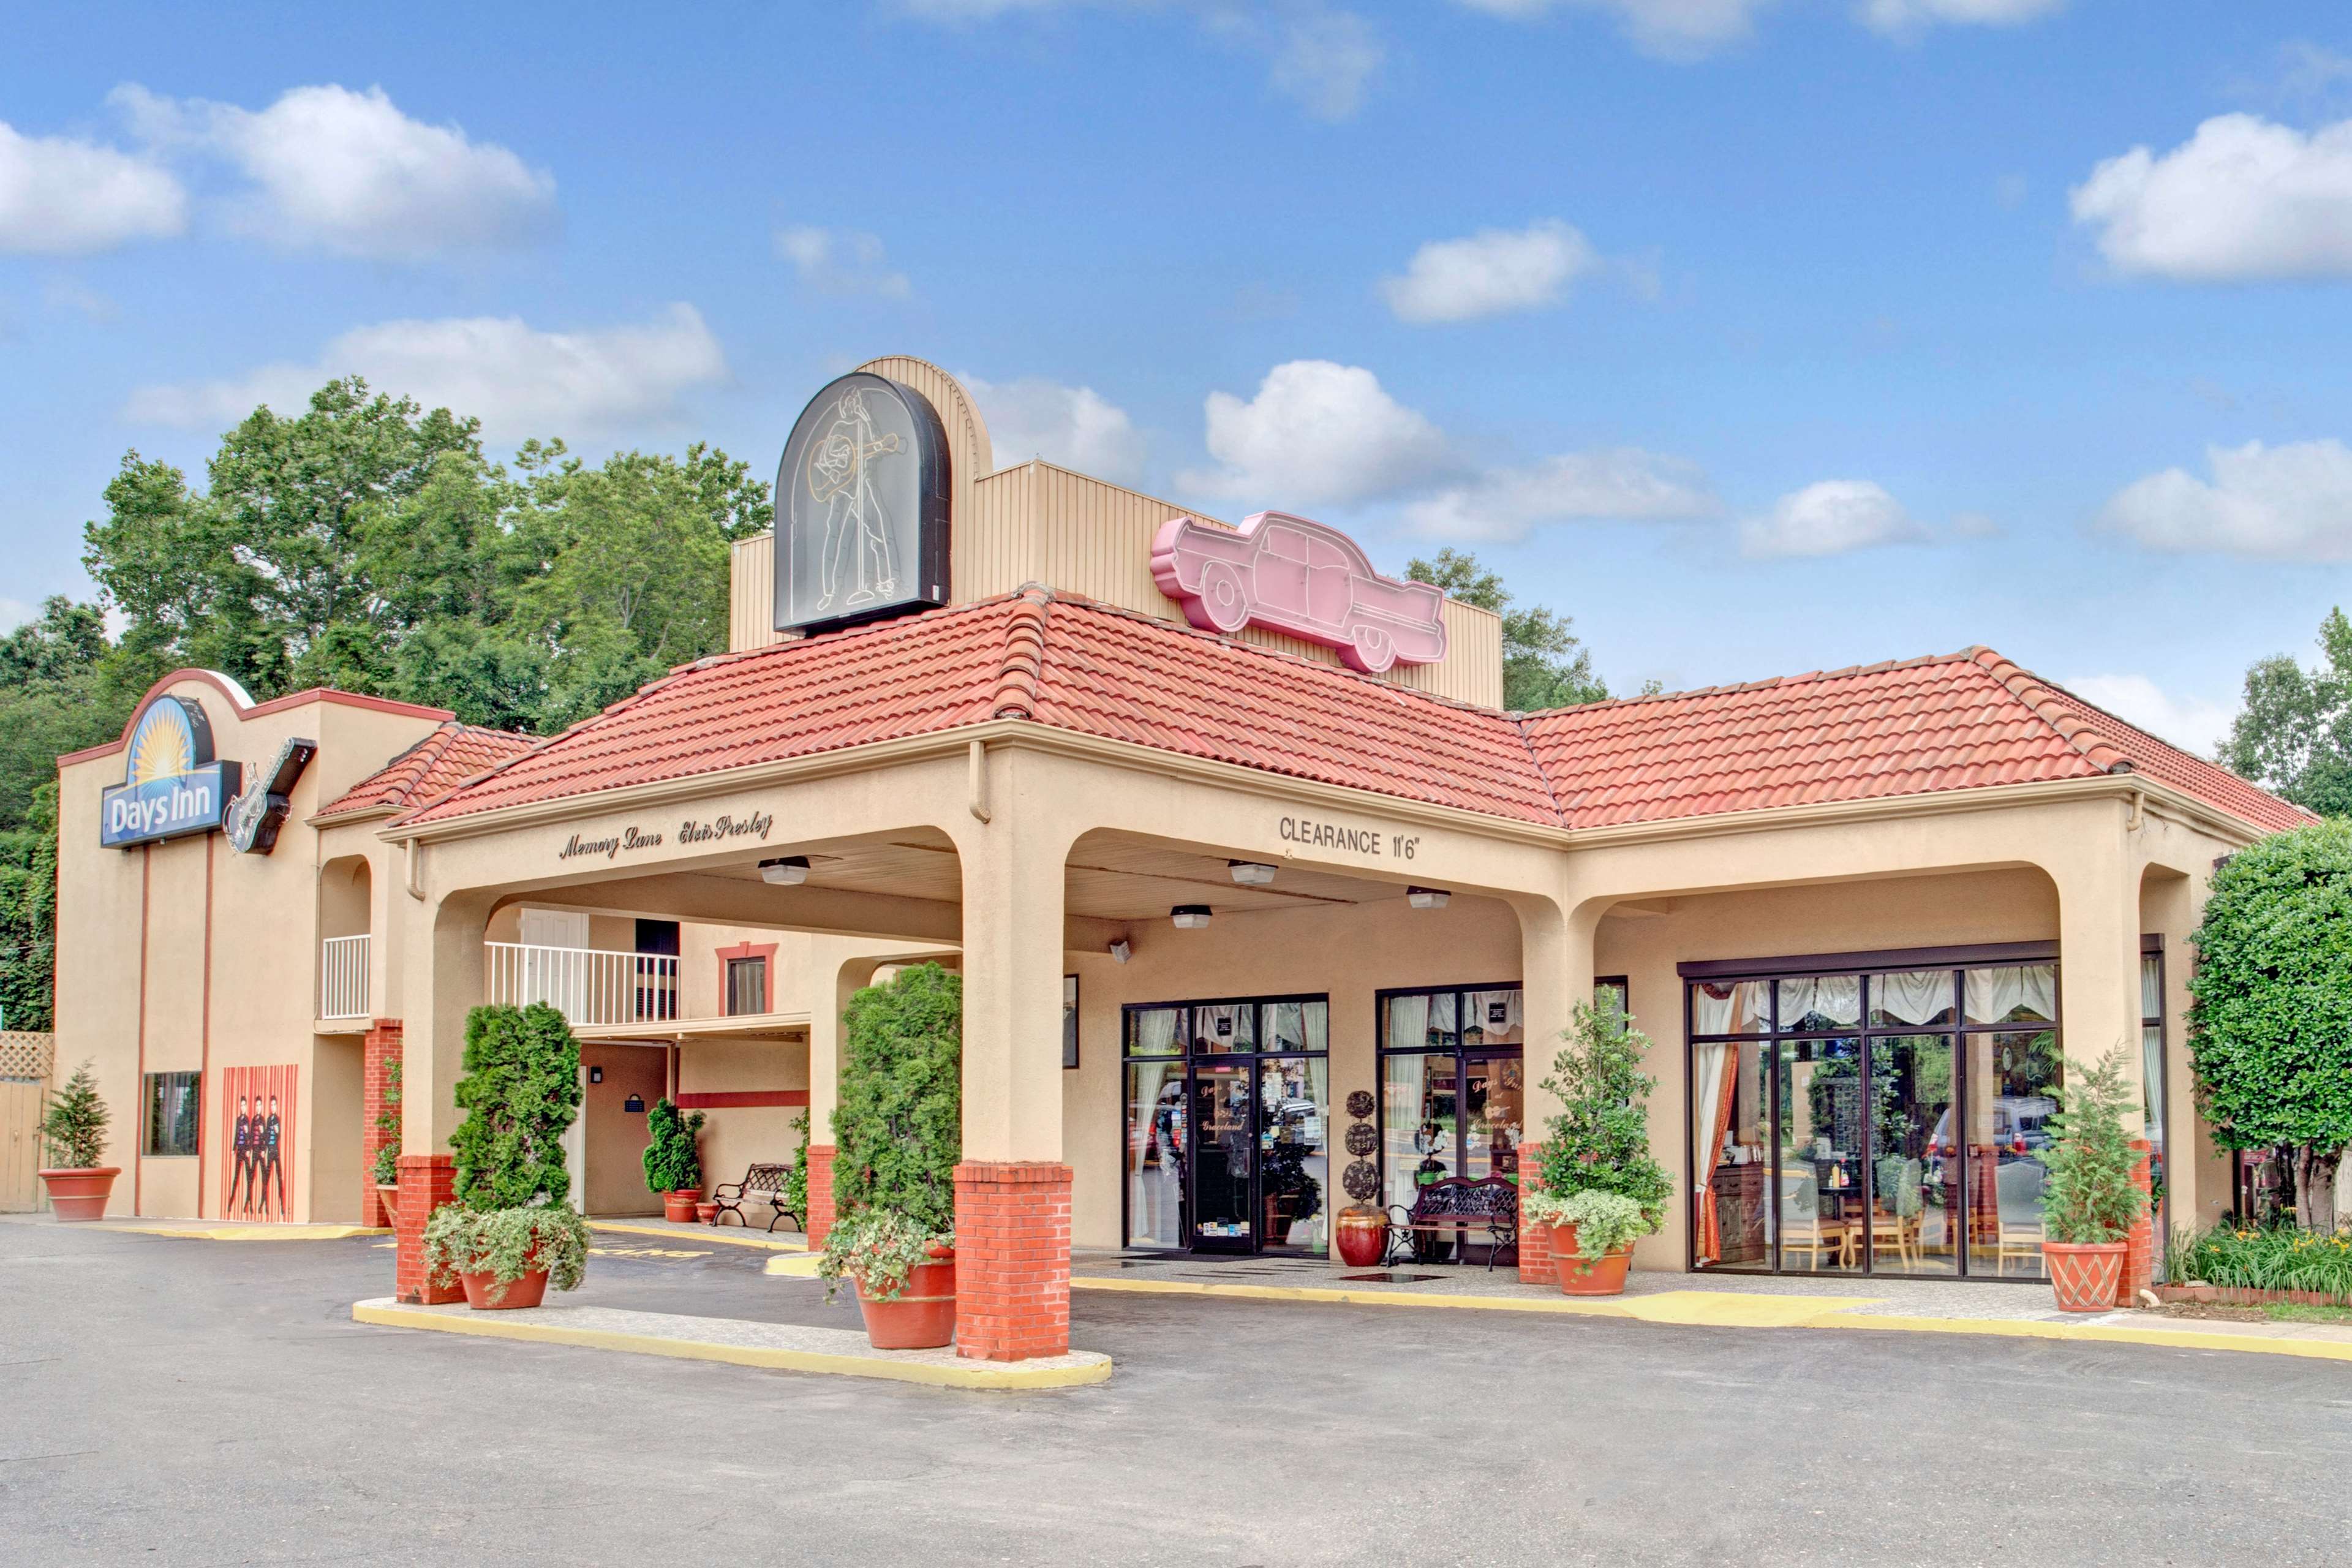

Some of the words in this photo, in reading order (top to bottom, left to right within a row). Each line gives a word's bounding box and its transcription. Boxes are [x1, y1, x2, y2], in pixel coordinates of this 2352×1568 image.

[111, 796, 168, 834] Days
[172, 785, 211, 821] Inn
[559, 834, 620, 859] Memory
[622, 826, 663, 850] Lane
[679, 820, 714, 843] Elvis
[714, 810, 773, 840] Presley
[1280, 816, 1381, 855] CLEARANCE
[1472, 1079, 1498, 1093] Days
[1201, 1120, 1245, 1130] Graceland
[587, 1248, 714, 1257] KING
